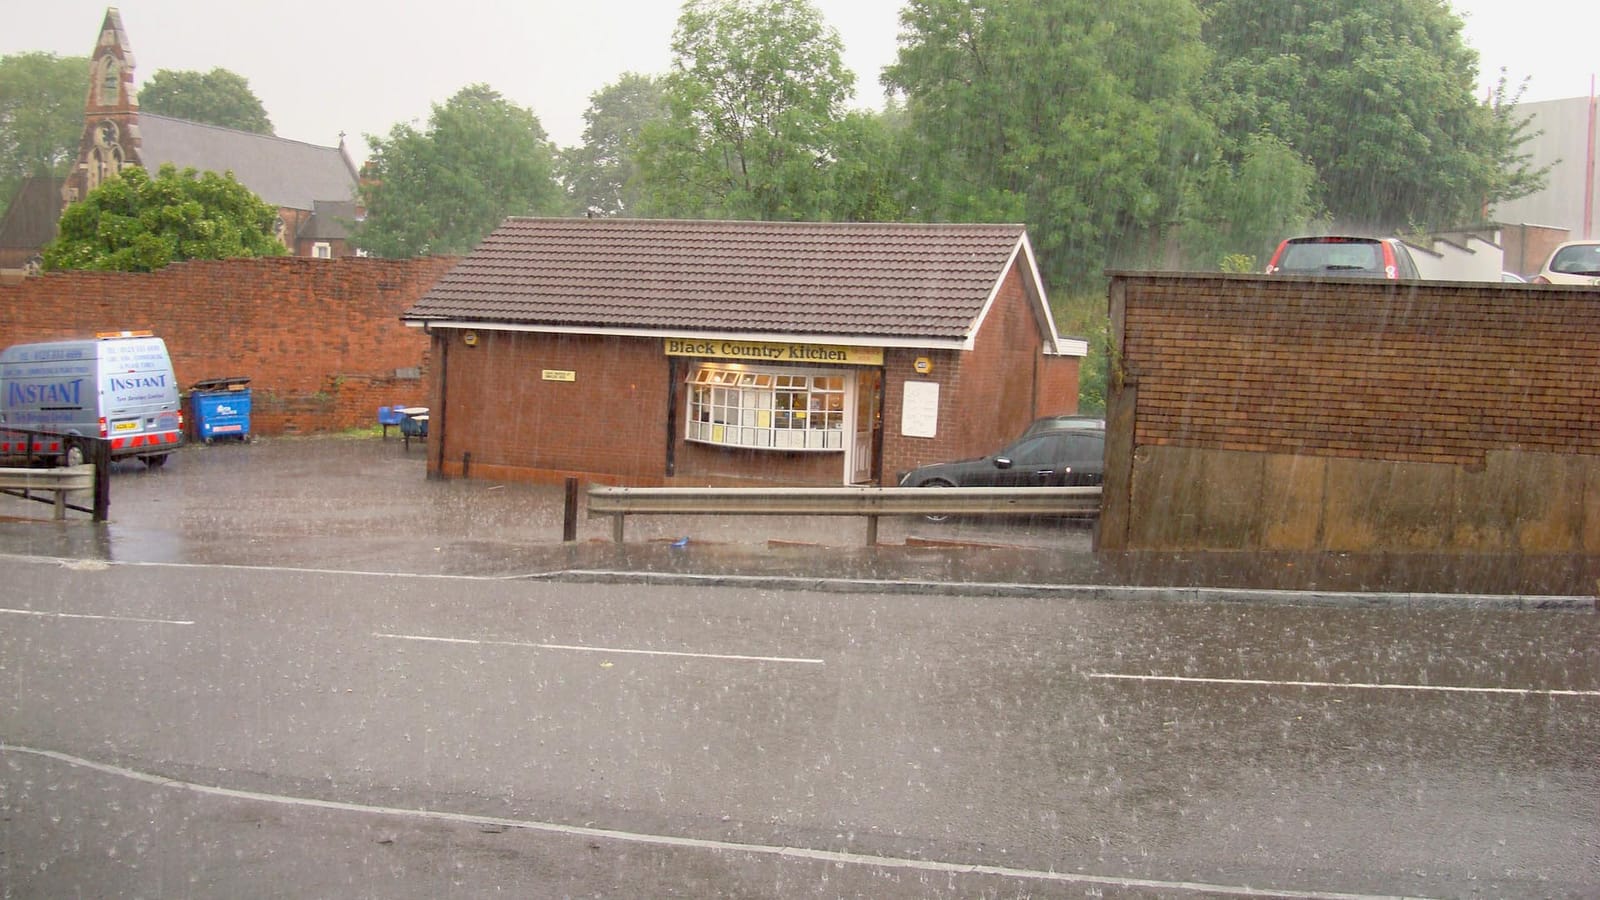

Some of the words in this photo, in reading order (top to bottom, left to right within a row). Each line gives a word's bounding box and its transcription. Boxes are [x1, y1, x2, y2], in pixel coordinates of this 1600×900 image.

[669, 340, 715, 354] Black
[721, 342, 784, 358] Country
[110, 374, 165, 391] INSTANT
[9, 378, 83, 407] INSTANT
